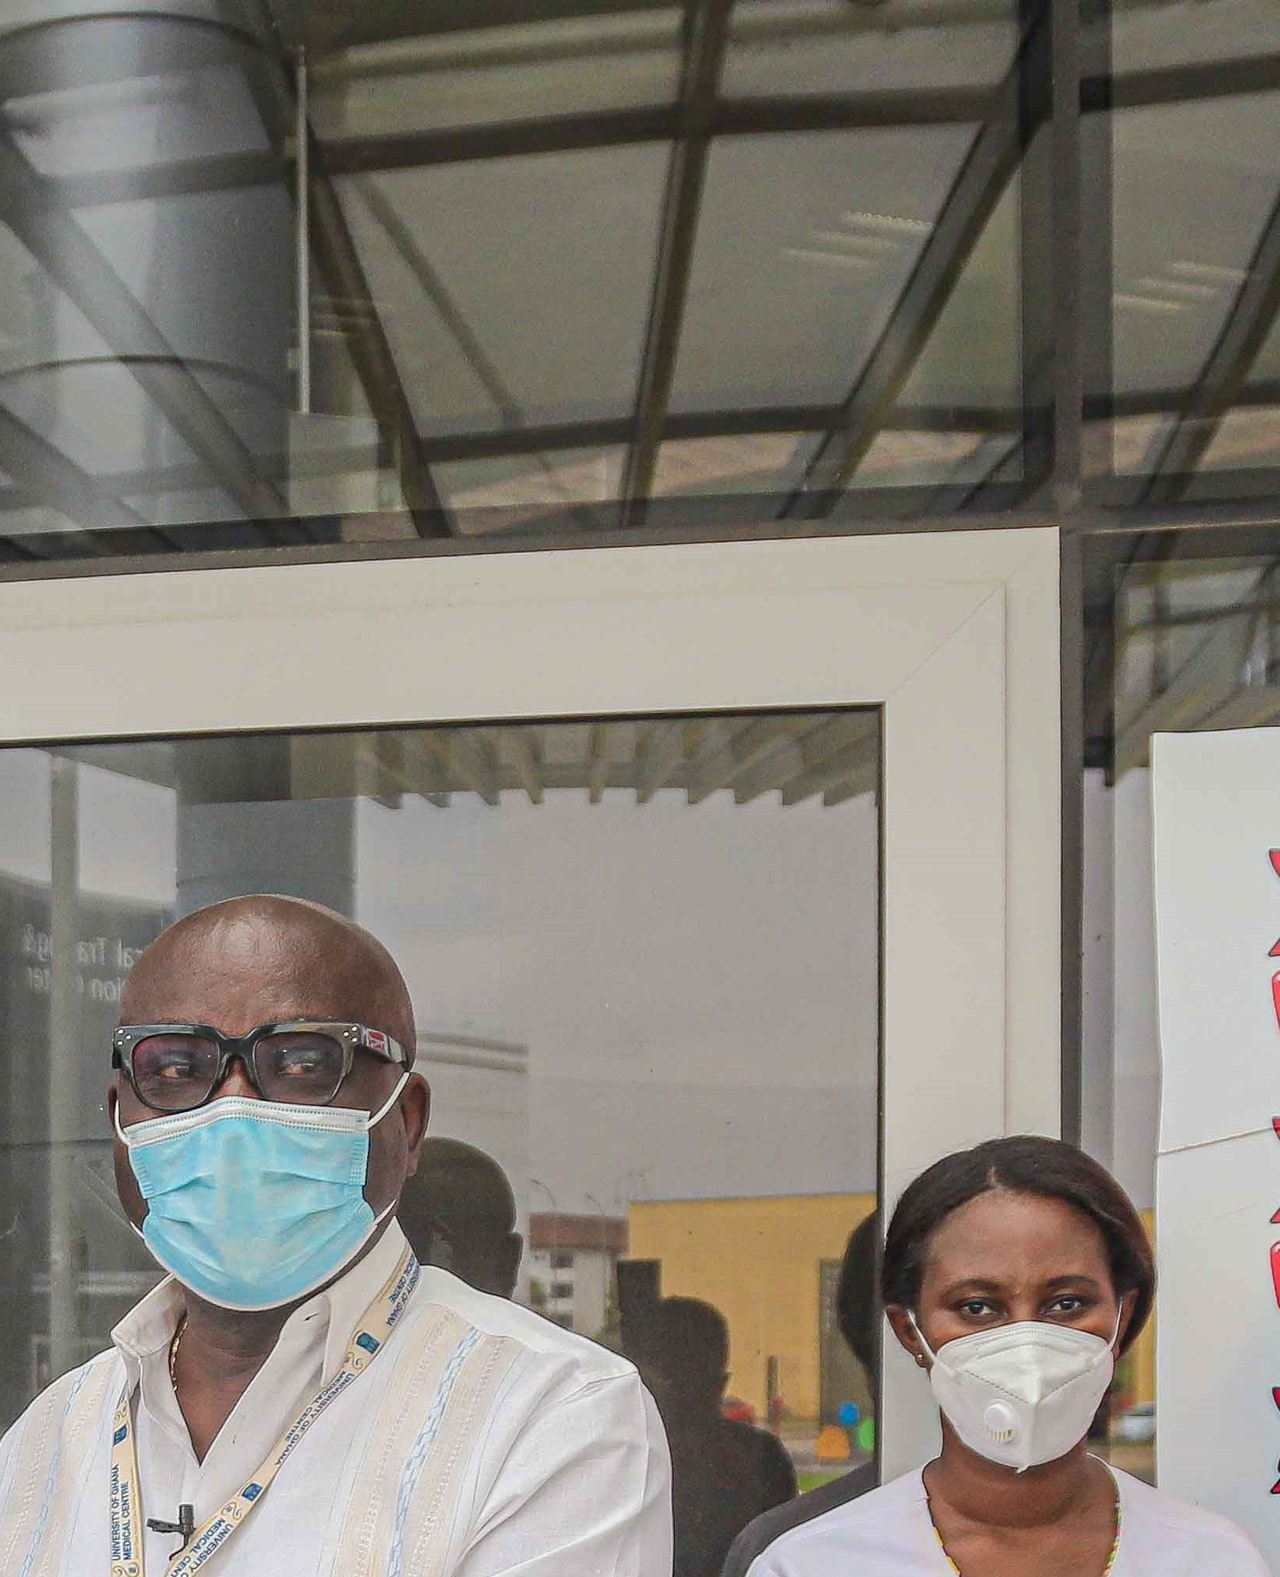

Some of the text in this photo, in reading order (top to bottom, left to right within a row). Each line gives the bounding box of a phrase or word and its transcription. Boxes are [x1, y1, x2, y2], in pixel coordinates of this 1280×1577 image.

[111, 1463, 121, 1561] UNIVERSITY OF GHANA
[121, 1481, 132, 1561] MEDICAL CENTRE
[189, 1518, 226, 1554] MEDICAL
[190, 1523, 234, 1573] UNIVERSITY
